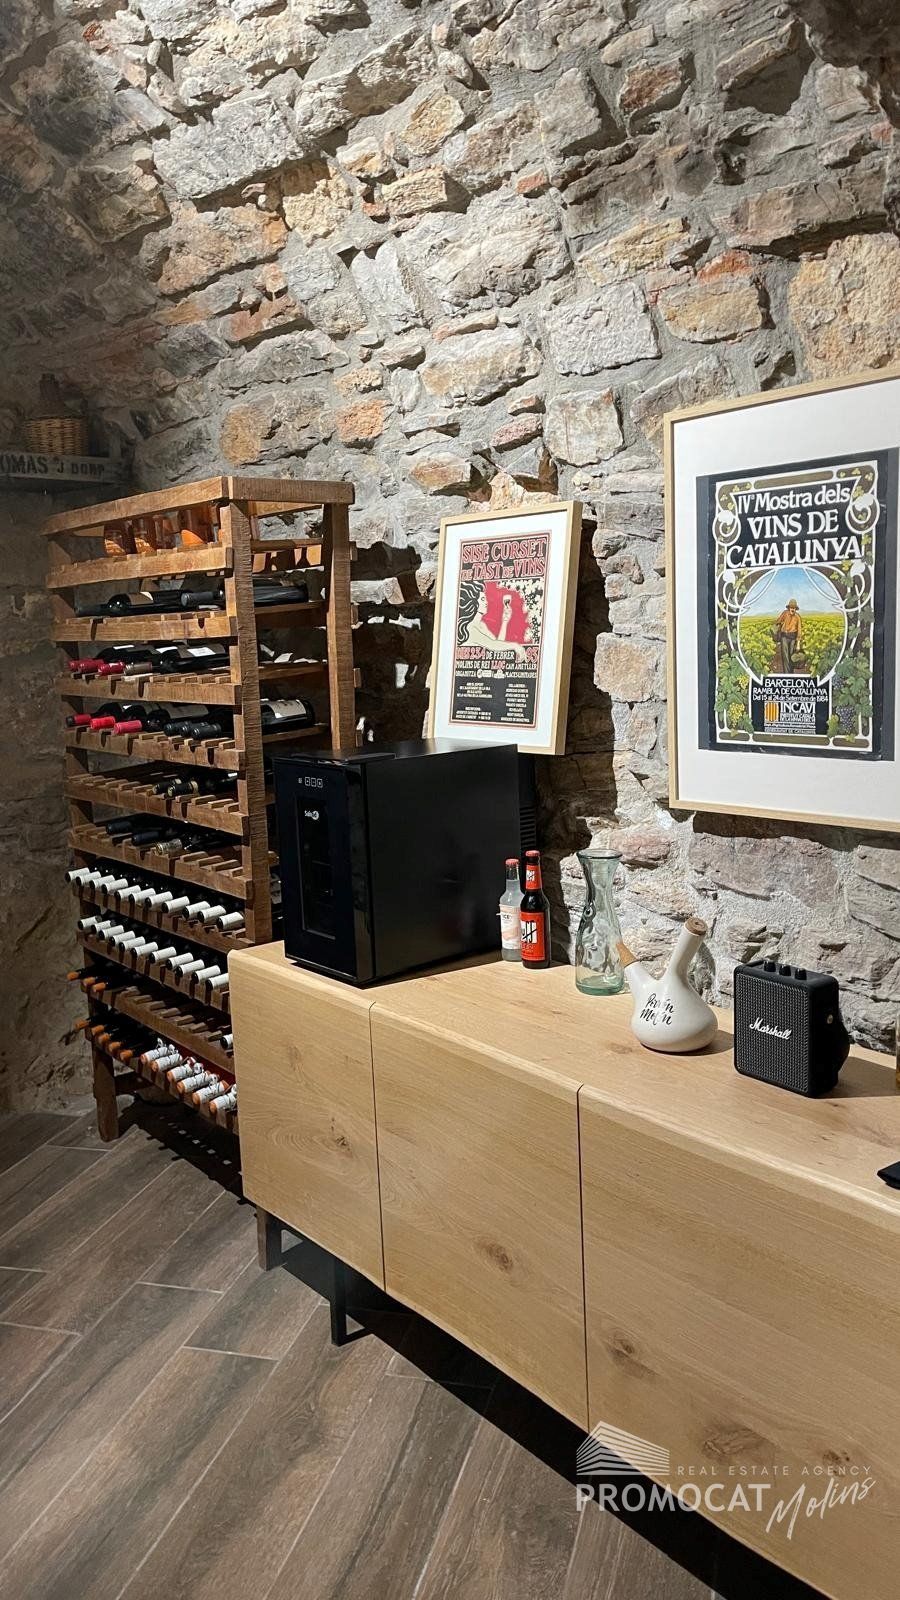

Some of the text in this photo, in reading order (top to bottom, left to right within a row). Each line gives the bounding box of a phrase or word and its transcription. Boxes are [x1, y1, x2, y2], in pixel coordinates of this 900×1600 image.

[754, 489, 812, 513] Mostra
[814, 483, 851, 505] dels
[747, 509, 840, 540] VINS DE
[491, 538, 546, 560] CURSET
[726, 535, 863, 569] CATALUNYA
[472, 561, 503, 580] TAST
[513, 557, 545, 577] VINS
[752, 687, 780, 695] RAMBLA
[791, 688, 828, 696] CATALUNYA
[764, 678, 815, 688] BARCELONA
[780, 701, 816, 714] INCAVI
[750, 1016, 792, 1040] Marshall
